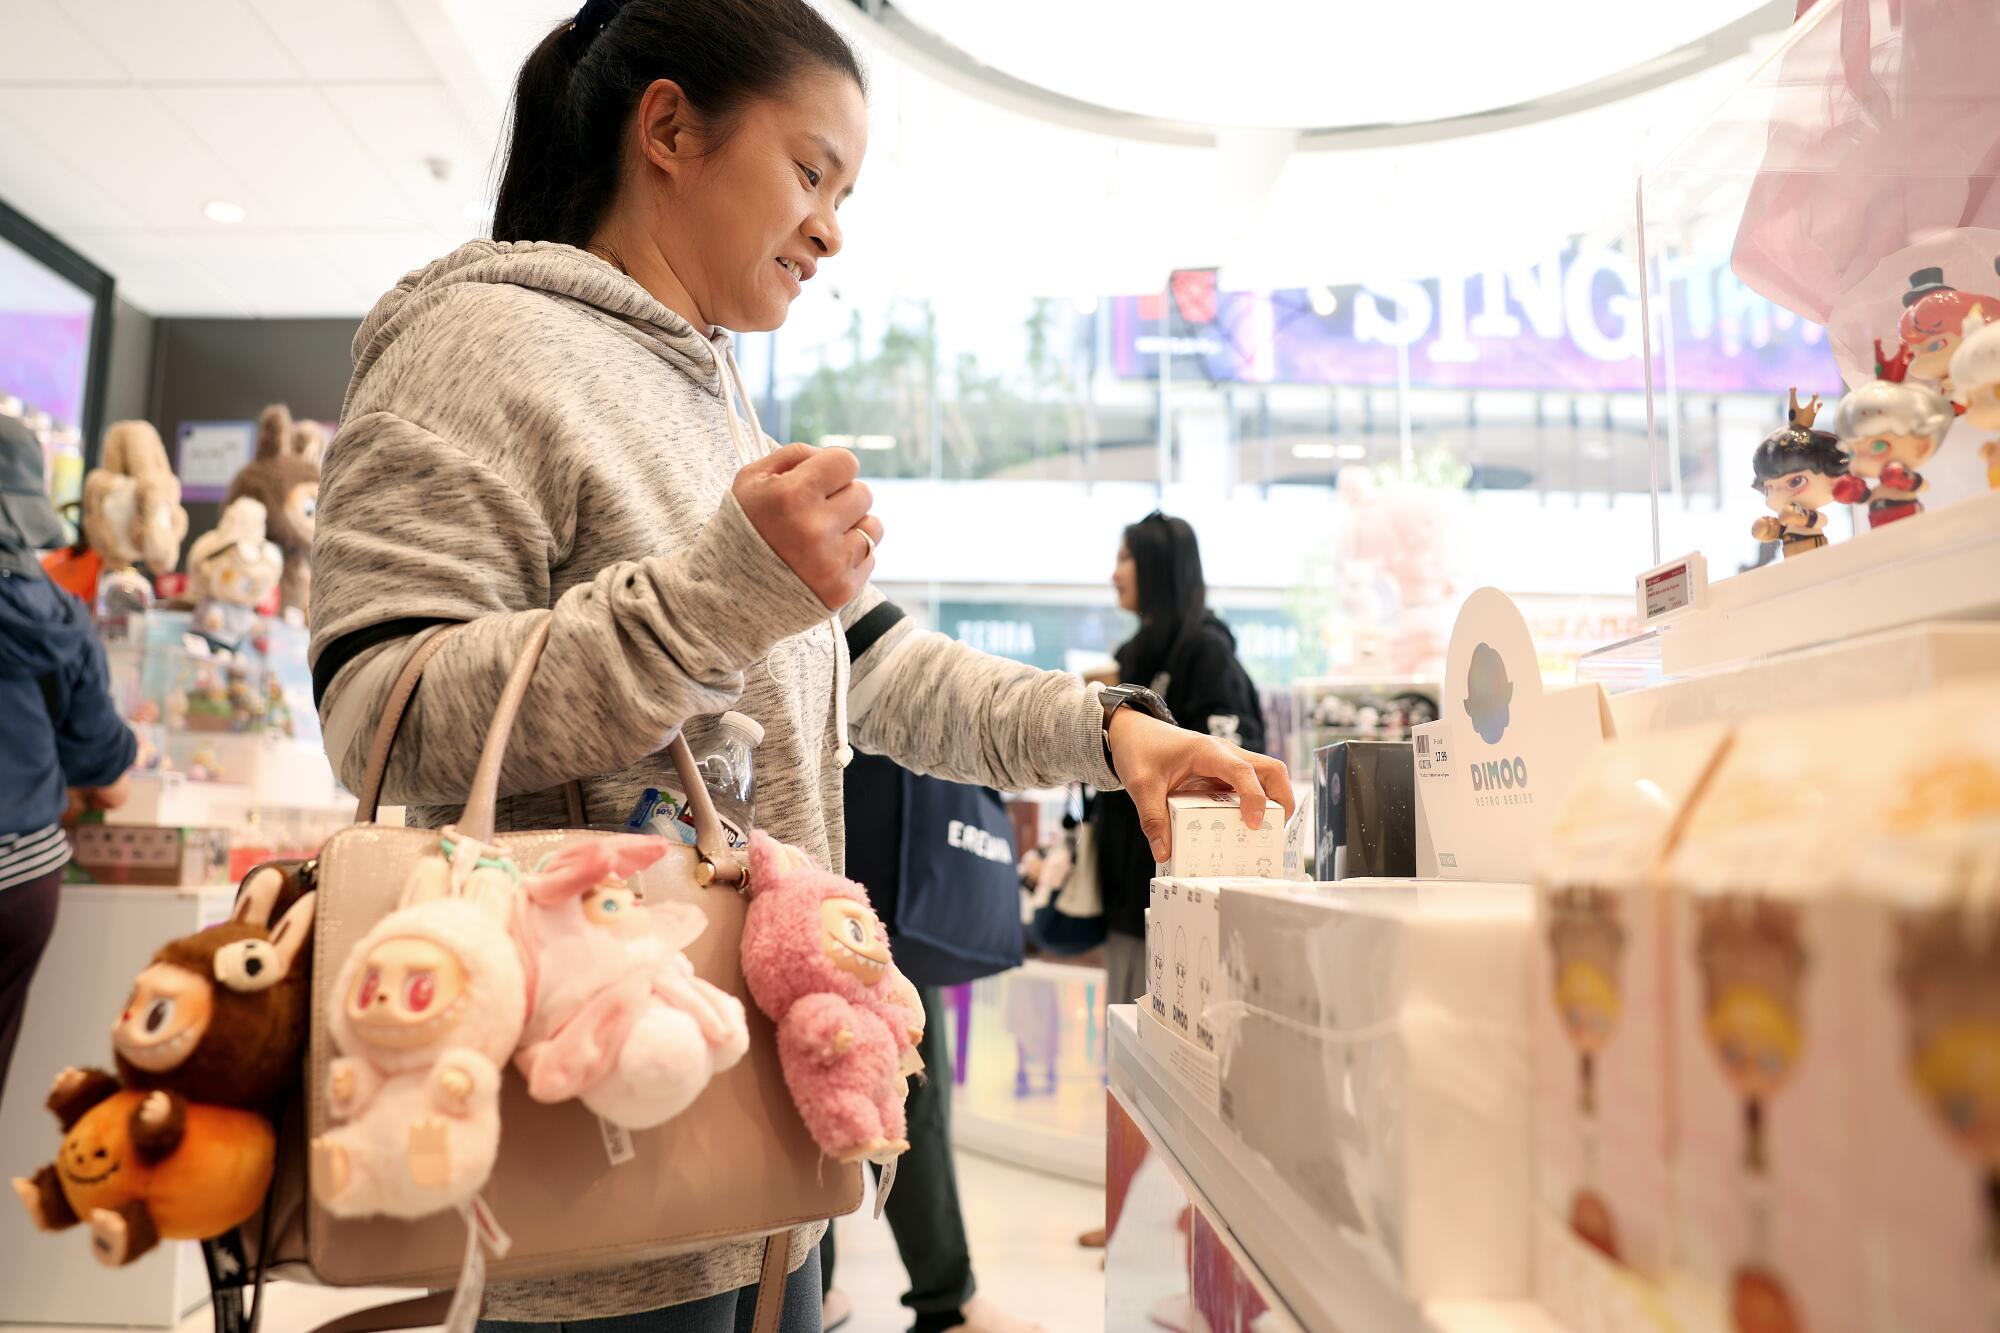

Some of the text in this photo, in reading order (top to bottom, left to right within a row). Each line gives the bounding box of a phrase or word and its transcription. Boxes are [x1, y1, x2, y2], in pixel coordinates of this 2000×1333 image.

[1470, 756, 1528, 791] DIMOO
[1475, 793, 1534, 807] RETRO SERIES
